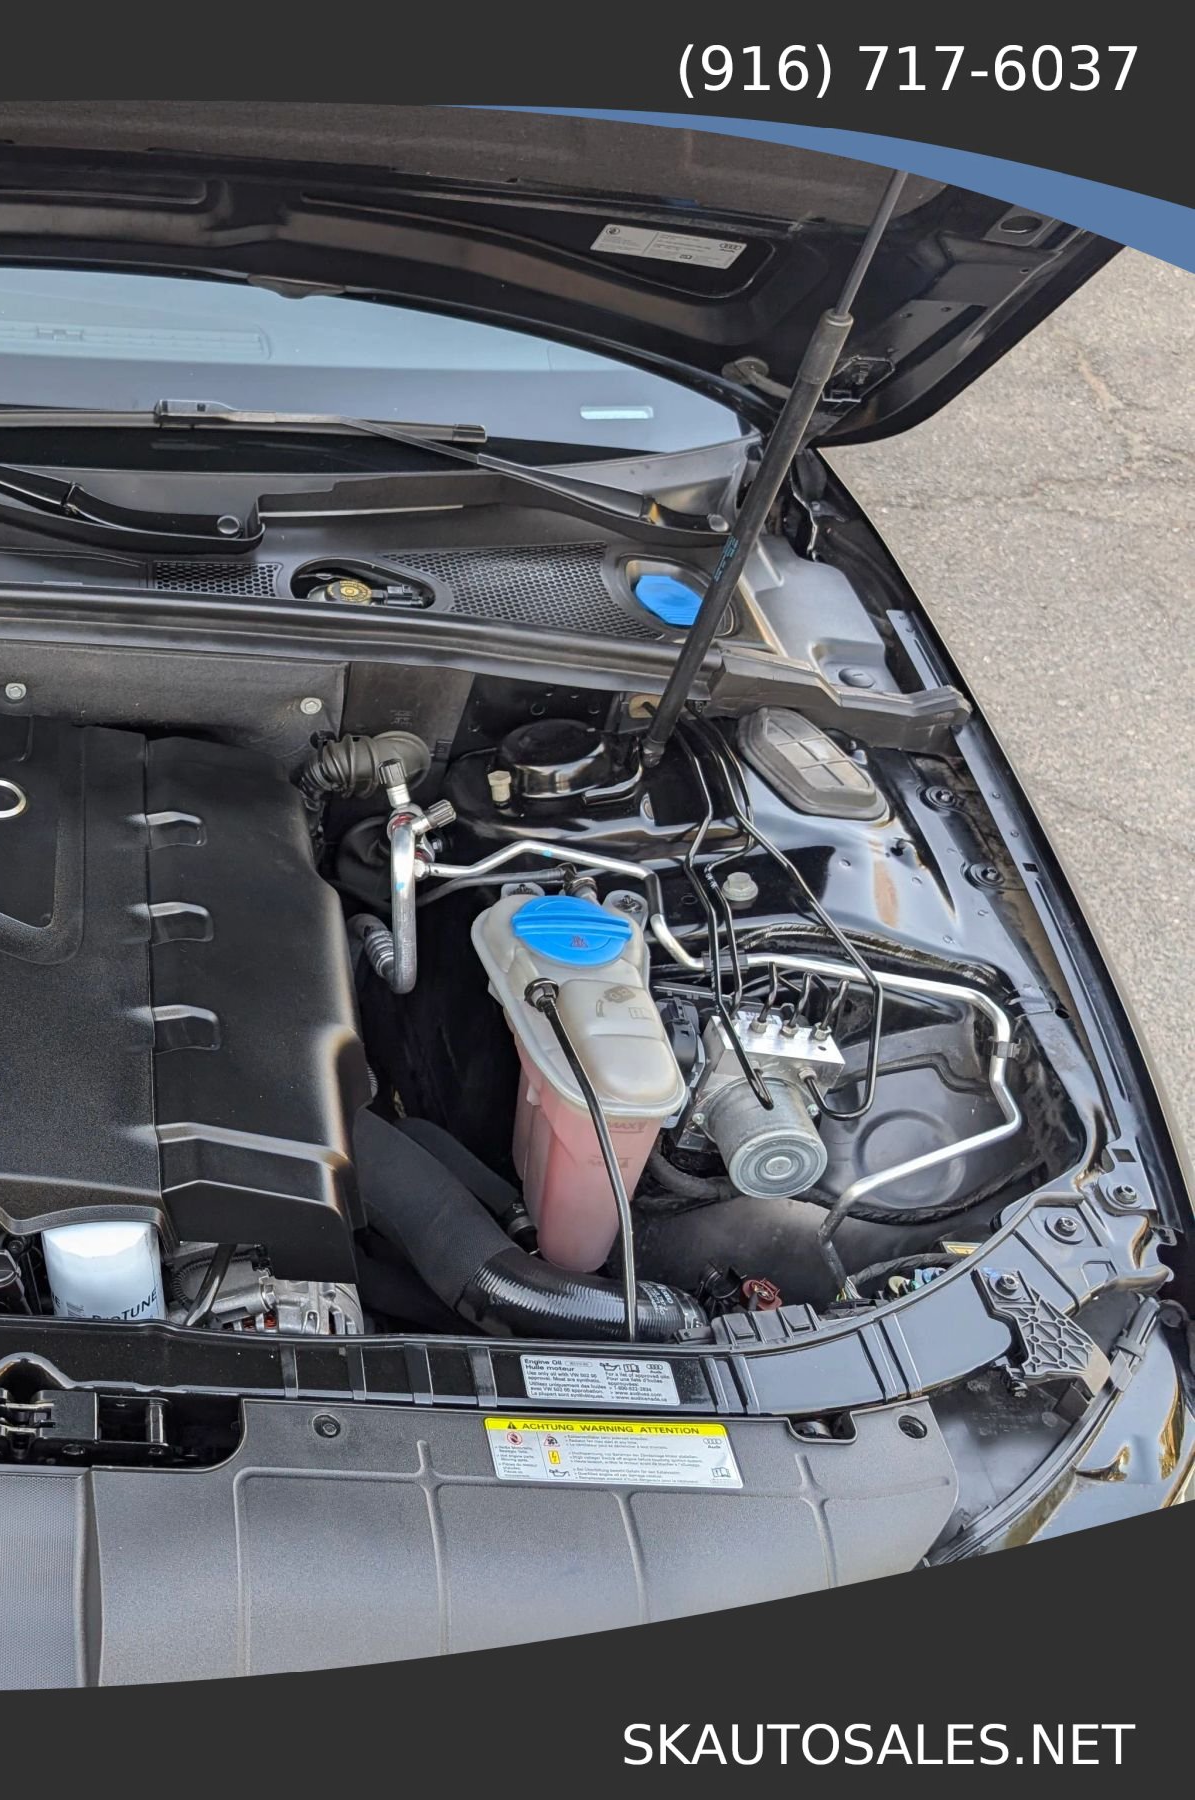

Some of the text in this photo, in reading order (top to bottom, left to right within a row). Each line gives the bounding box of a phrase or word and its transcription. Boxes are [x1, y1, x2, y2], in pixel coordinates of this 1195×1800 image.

[522, 1423, 699, 1434] ACHTUNG WARNING ATTENTION
